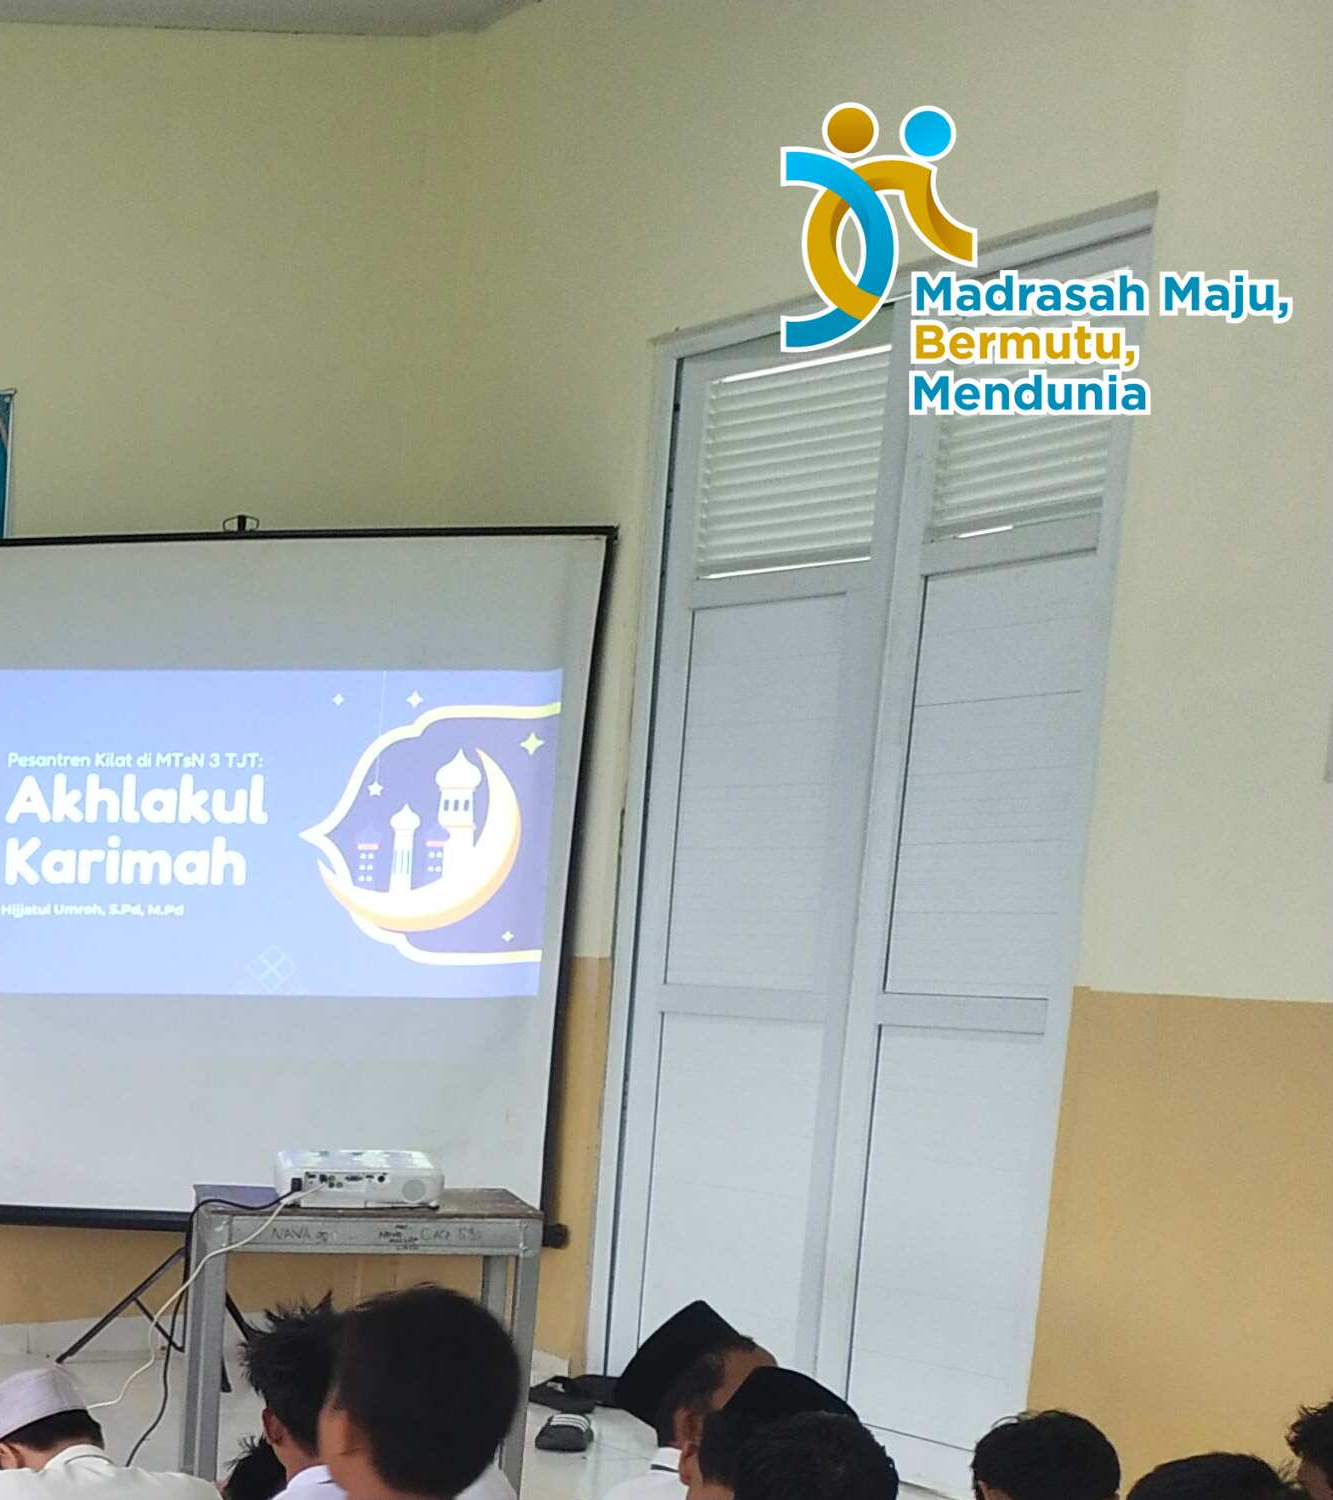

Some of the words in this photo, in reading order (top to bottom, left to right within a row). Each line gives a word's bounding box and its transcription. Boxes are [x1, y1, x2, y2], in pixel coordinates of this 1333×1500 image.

[7, 752, 91, 768] Pesantren
[94, 752, 133, 768] Kilat
[136, 752, 152, 768] di
[155, 752, 206, 768] MTsN
[209, 752, 221, 768] 3
[224, 752, 264, 768] TJT:
[4, 773, 269, 826] Akhlakul
[4, 835, 247, 887] Karimah
